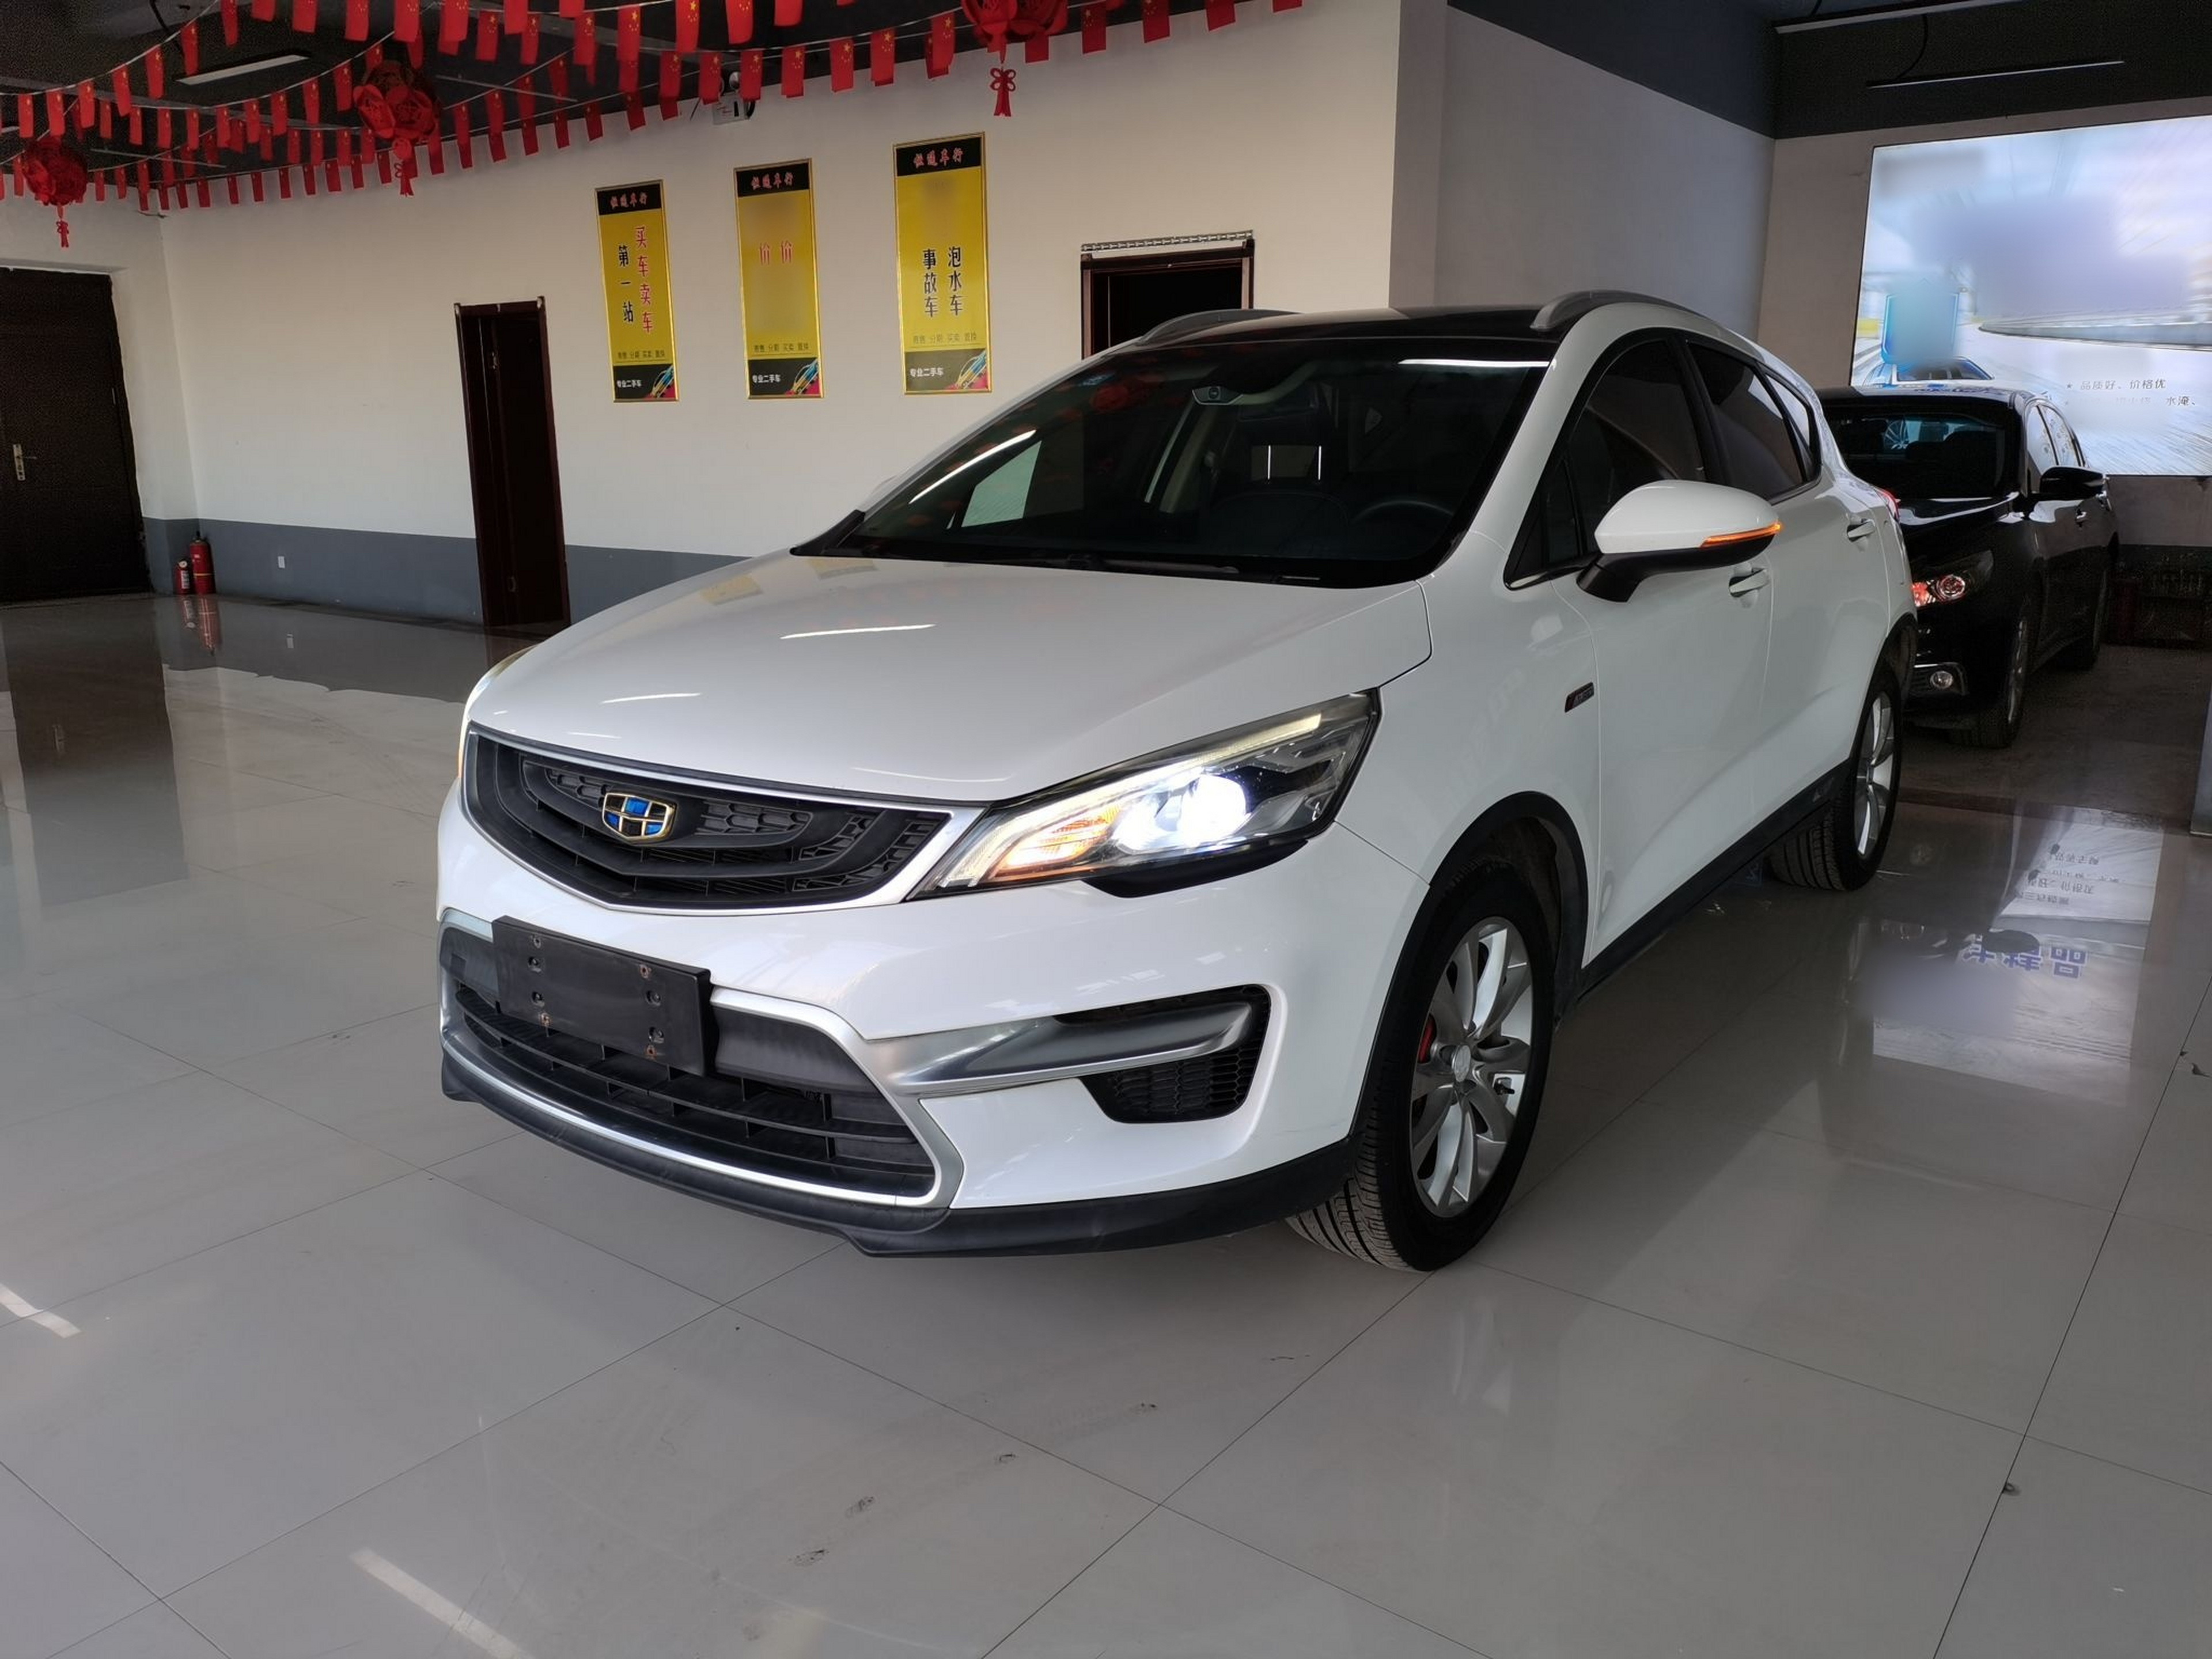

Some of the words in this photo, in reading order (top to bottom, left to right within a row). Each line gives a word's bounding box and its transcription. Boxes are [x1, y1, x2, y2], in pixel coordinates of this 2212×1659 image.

[618, 245, 634, 323] 第一站
[635, 226, 653, 333] 买车卖车
[923, 248, 938, 317] 事故车
[948, 246, 963, 316] 泡水车
[752, 374, 781, 383] 专业二手车
[910, 368, 944, 377] 专业二手车
